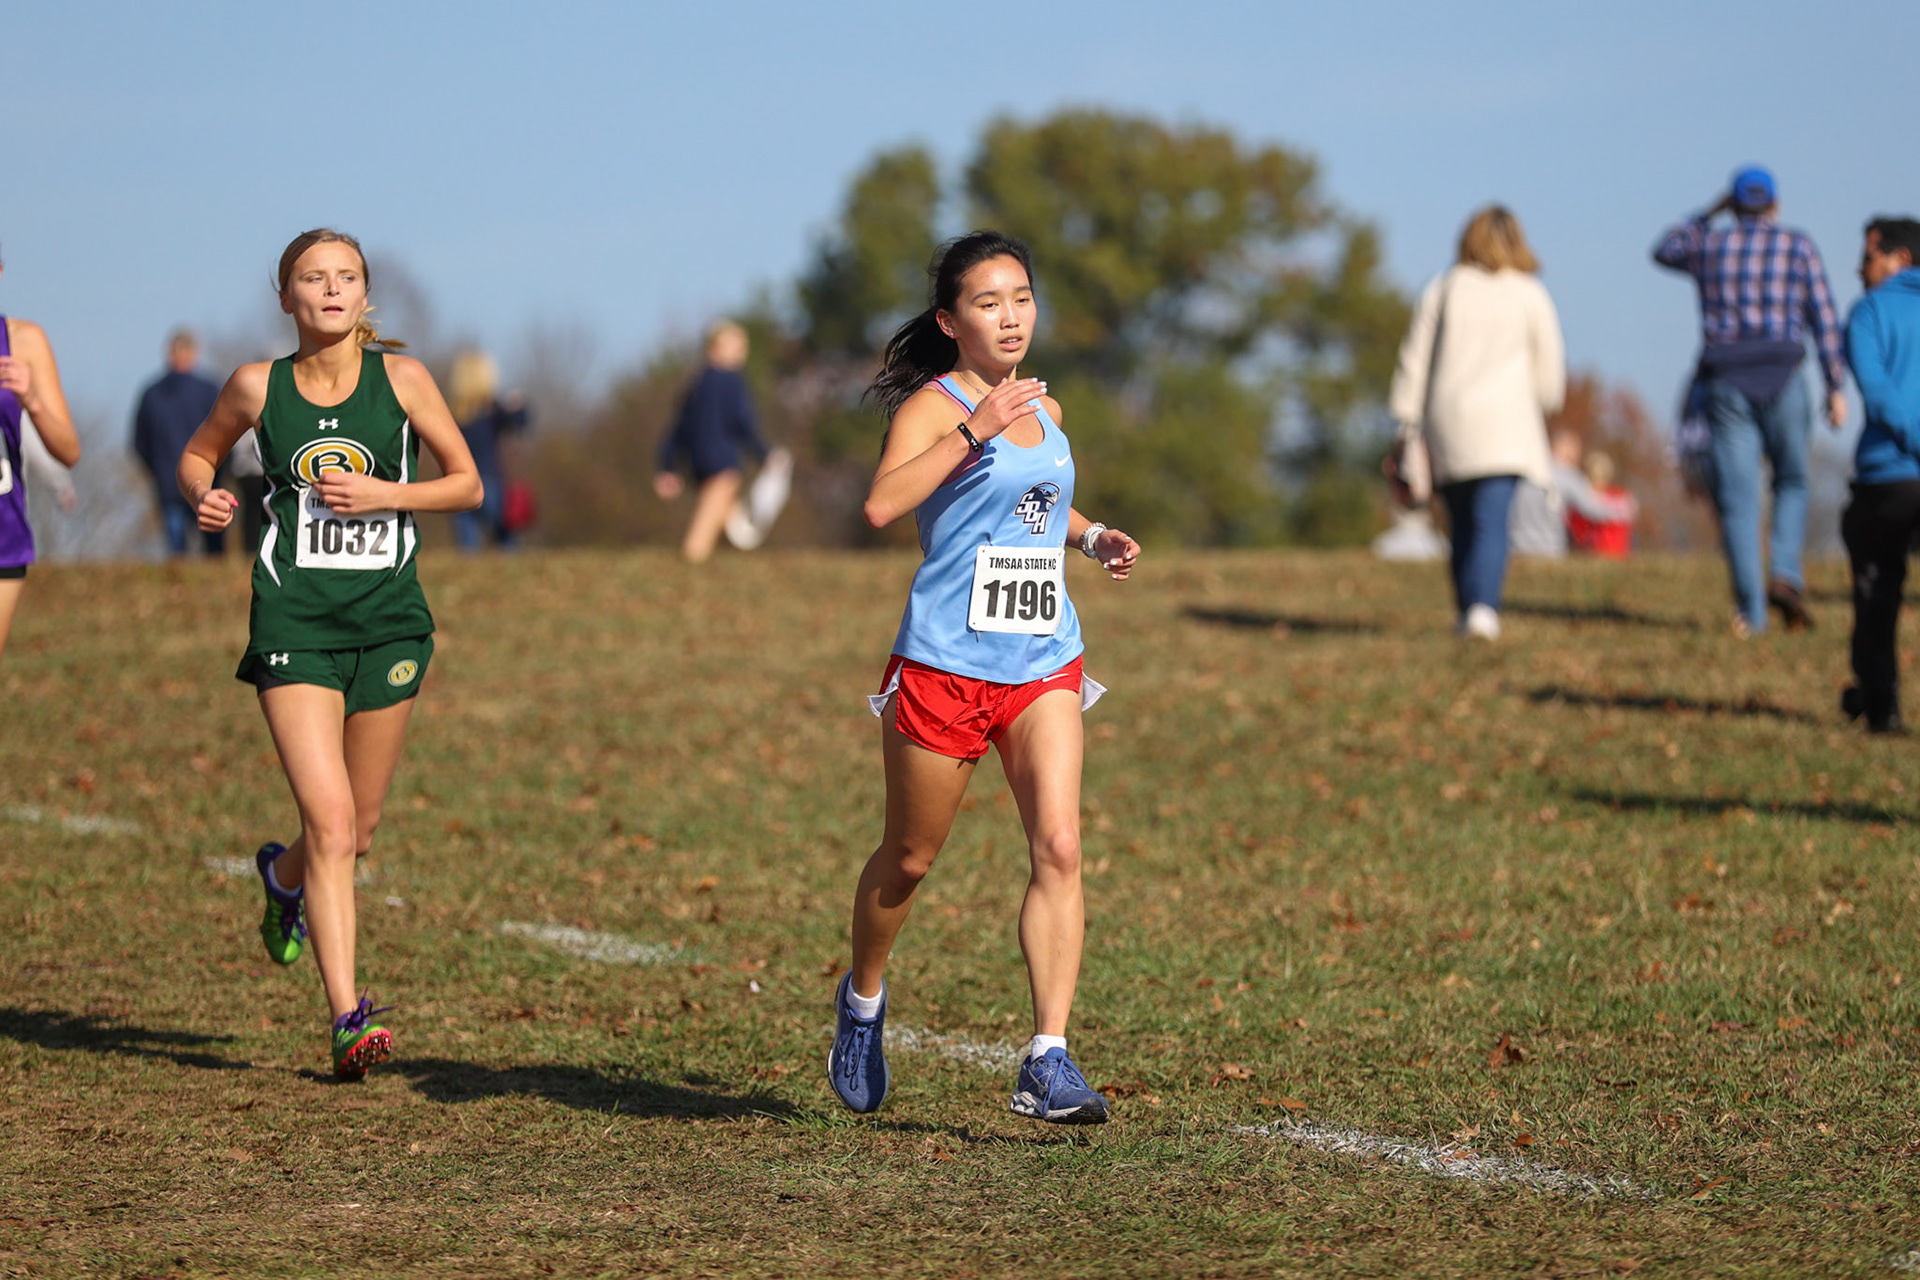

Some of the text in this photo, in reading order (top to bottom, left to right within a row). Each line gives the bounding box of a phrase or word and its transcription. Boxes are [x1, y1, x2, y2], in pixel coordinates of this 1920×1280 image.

[1014, 492, 1048, 535] SBA
[305, 518, 389, 555] 1032
[989, 557, 1022, 570] TMSAA
[1024, 558, 1047, 570] STATE
[983, 579, 1056, 621] 1196
